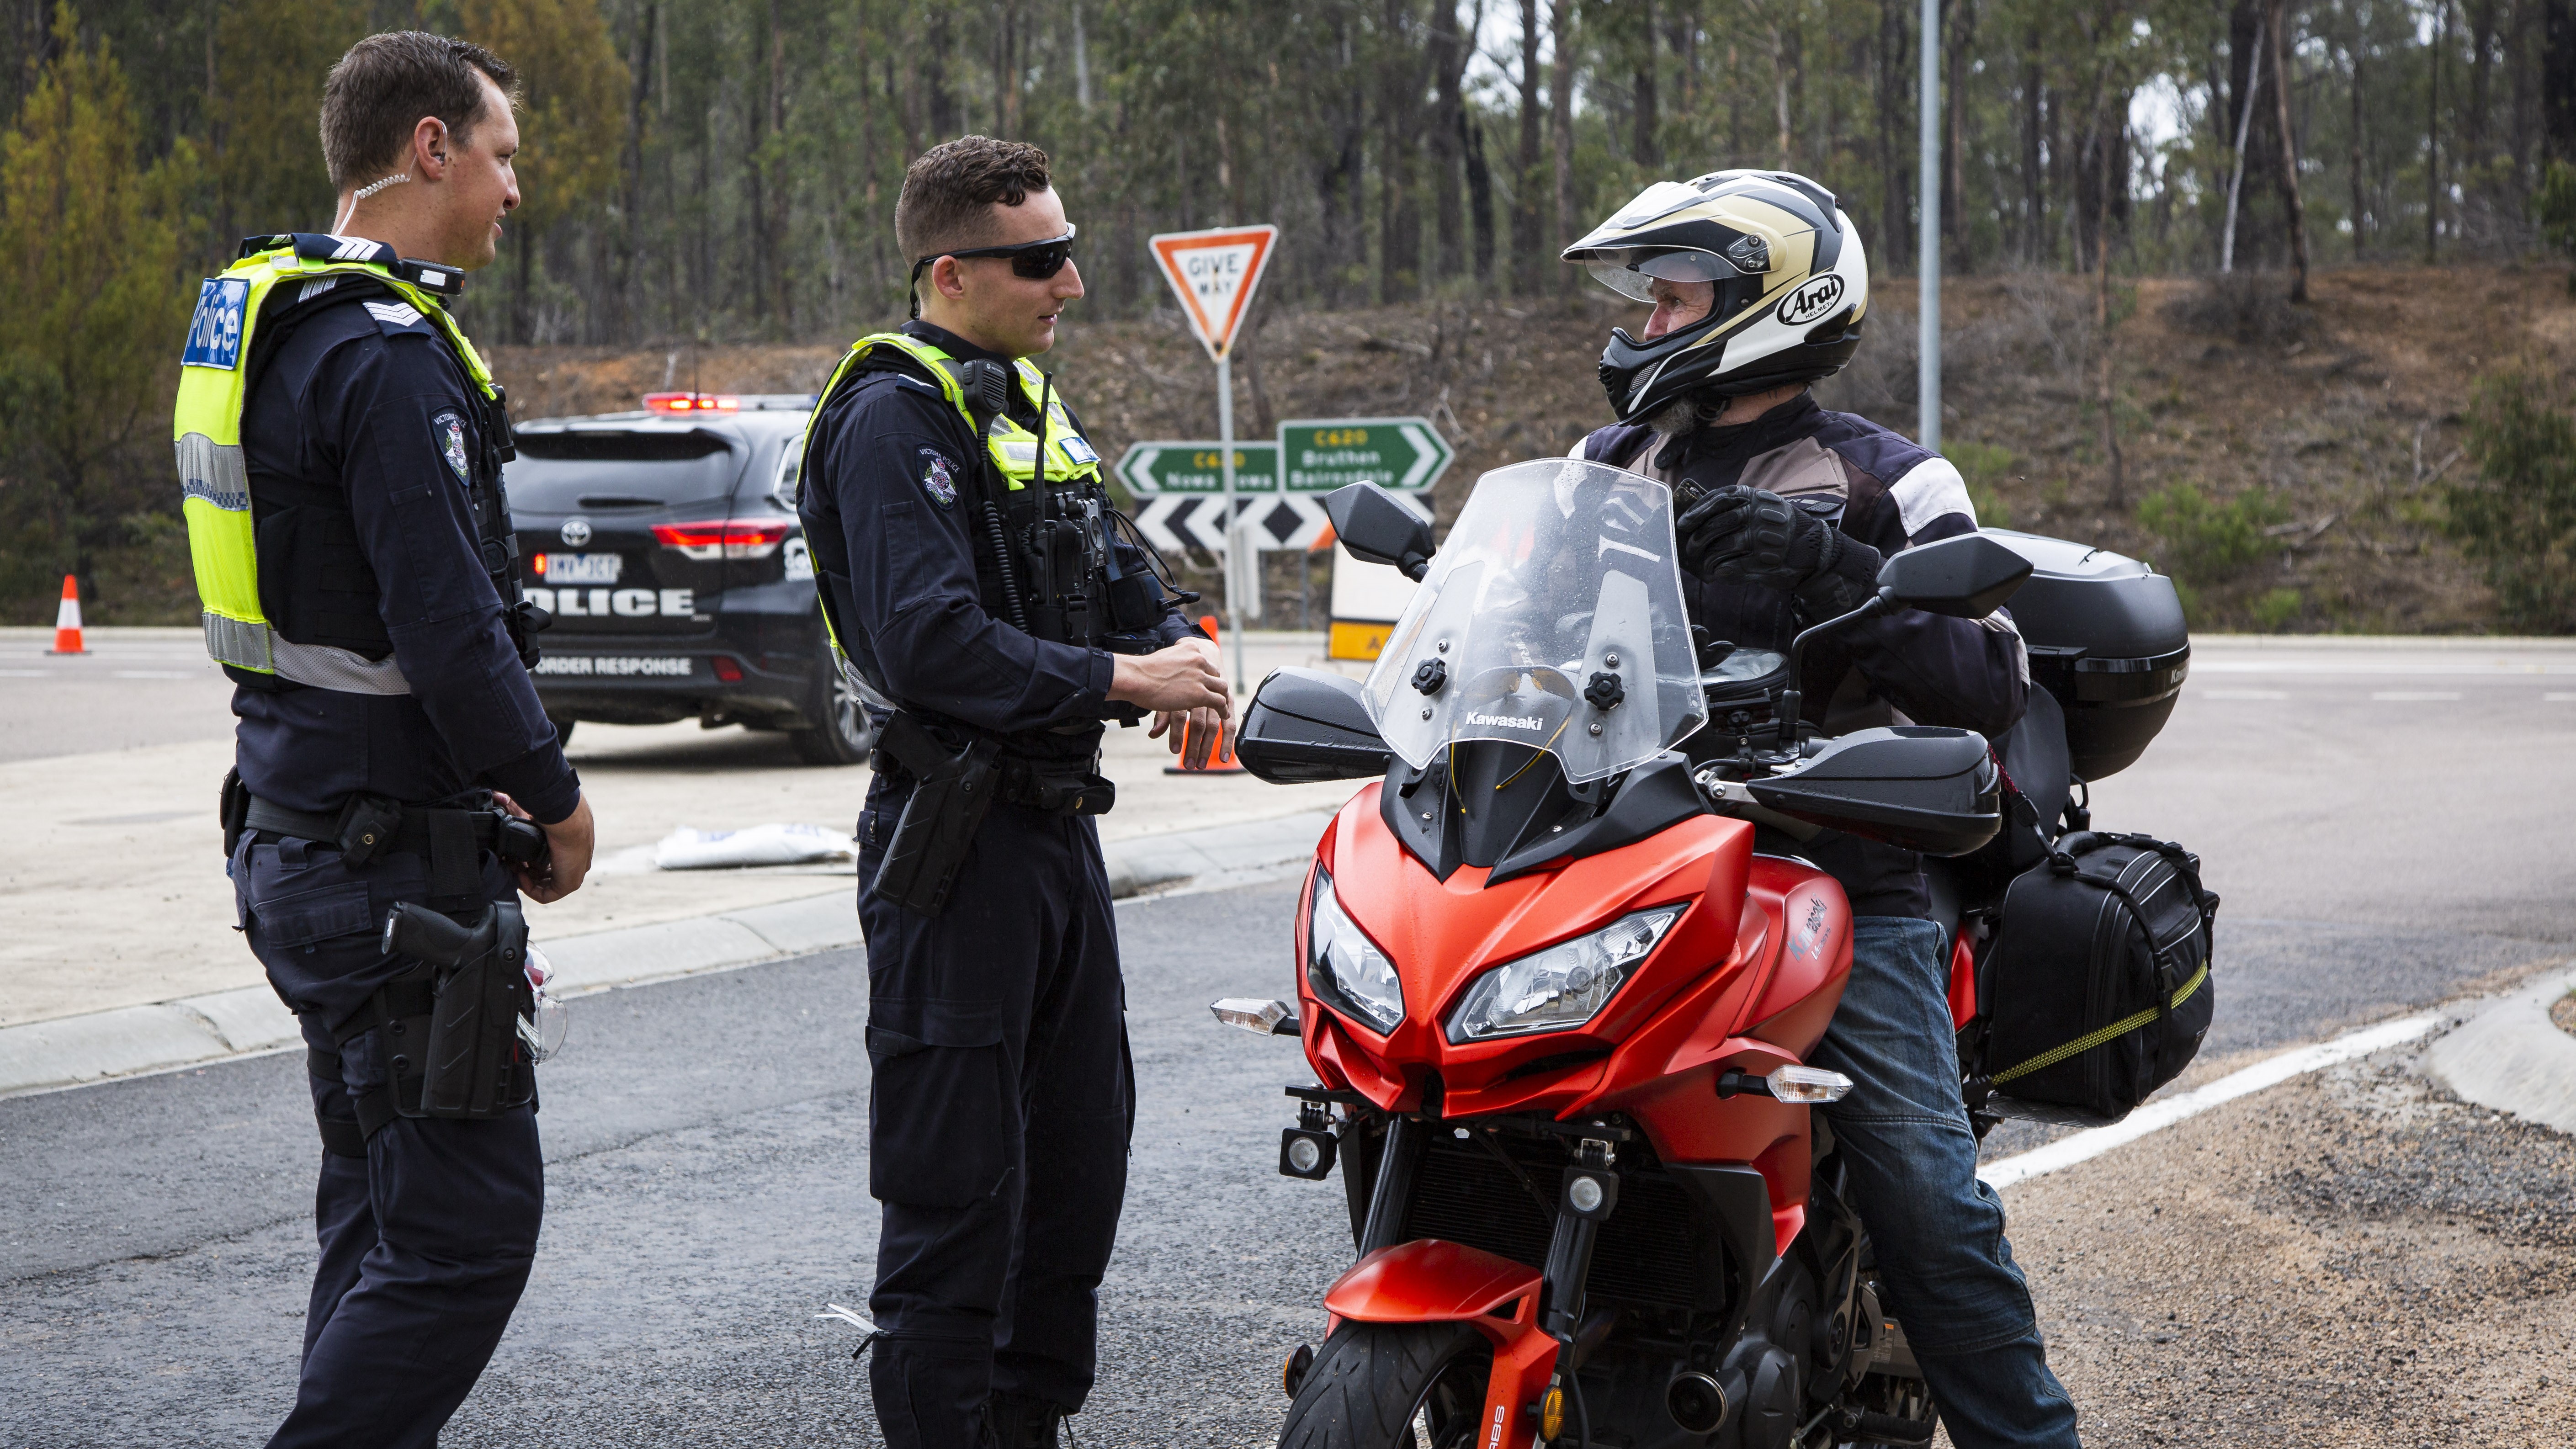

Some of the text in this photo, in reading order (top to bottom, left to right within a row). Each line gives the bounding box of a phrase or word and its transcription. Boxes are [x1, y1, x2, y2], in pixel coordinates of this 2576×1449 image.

[1188, 253, 1239, 276] GIVE
[1199, 278, 1233, 296] WAY
[1785, 275, 1839, 323] Arai
[187, 294, 238, 351] Police
[434, 413, 455, 425] VICTORIA
[1313, 429, 1369, 447] C620
[919, 448, 960, 473] VICTORIA POLICE
[1193, 451, 1246, 469] C60
[1301, 450, 1381, 467] Bruthen
[1234, 474, 1273, 488] owa
[523, 588, 695, 616] OLICE
[533, 657, 691, 675] ORDER RESPONSE
[1465, 711, 1543, 731] Kawasaki
[1787, 893, 1828, 961] Kawasaki
